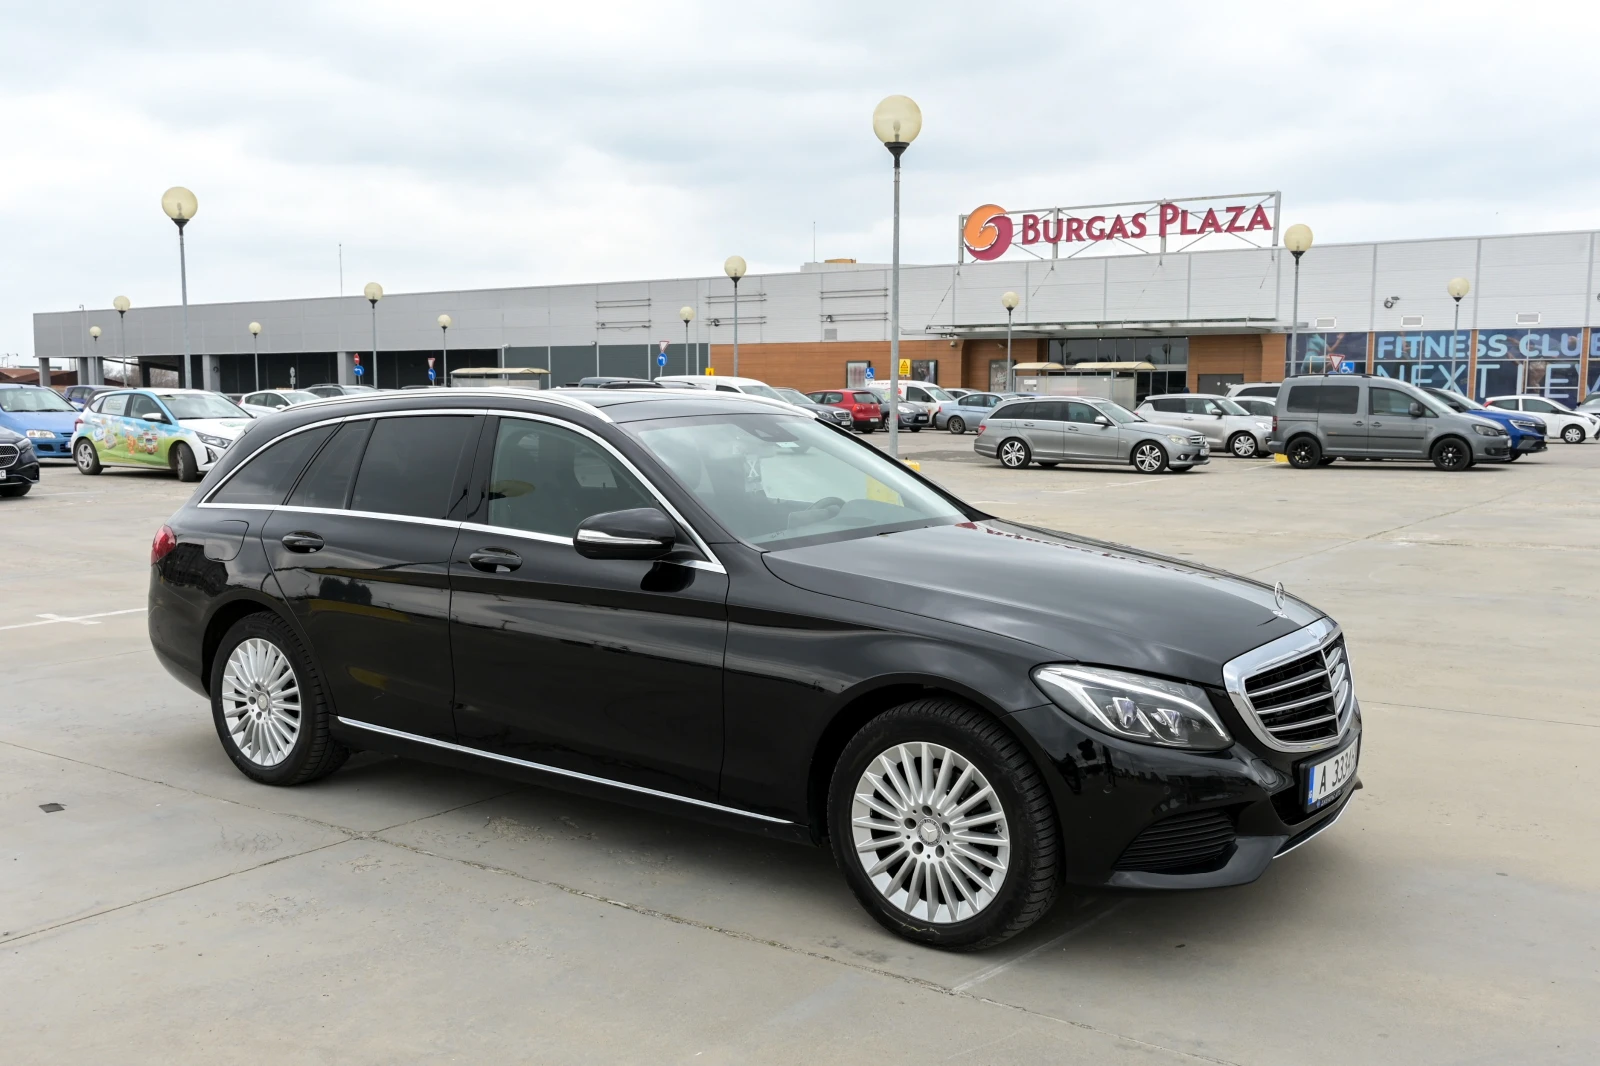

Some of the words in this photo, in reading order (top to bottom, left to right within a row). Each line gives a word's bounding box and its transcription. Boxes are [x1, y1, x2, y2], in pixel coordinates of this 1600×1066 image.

[1022, 213, 1146, 245] BURGAS
[1159, 203, 1272, 237] PLAZA
[1377, 333, 1508, 359] FITNESS
